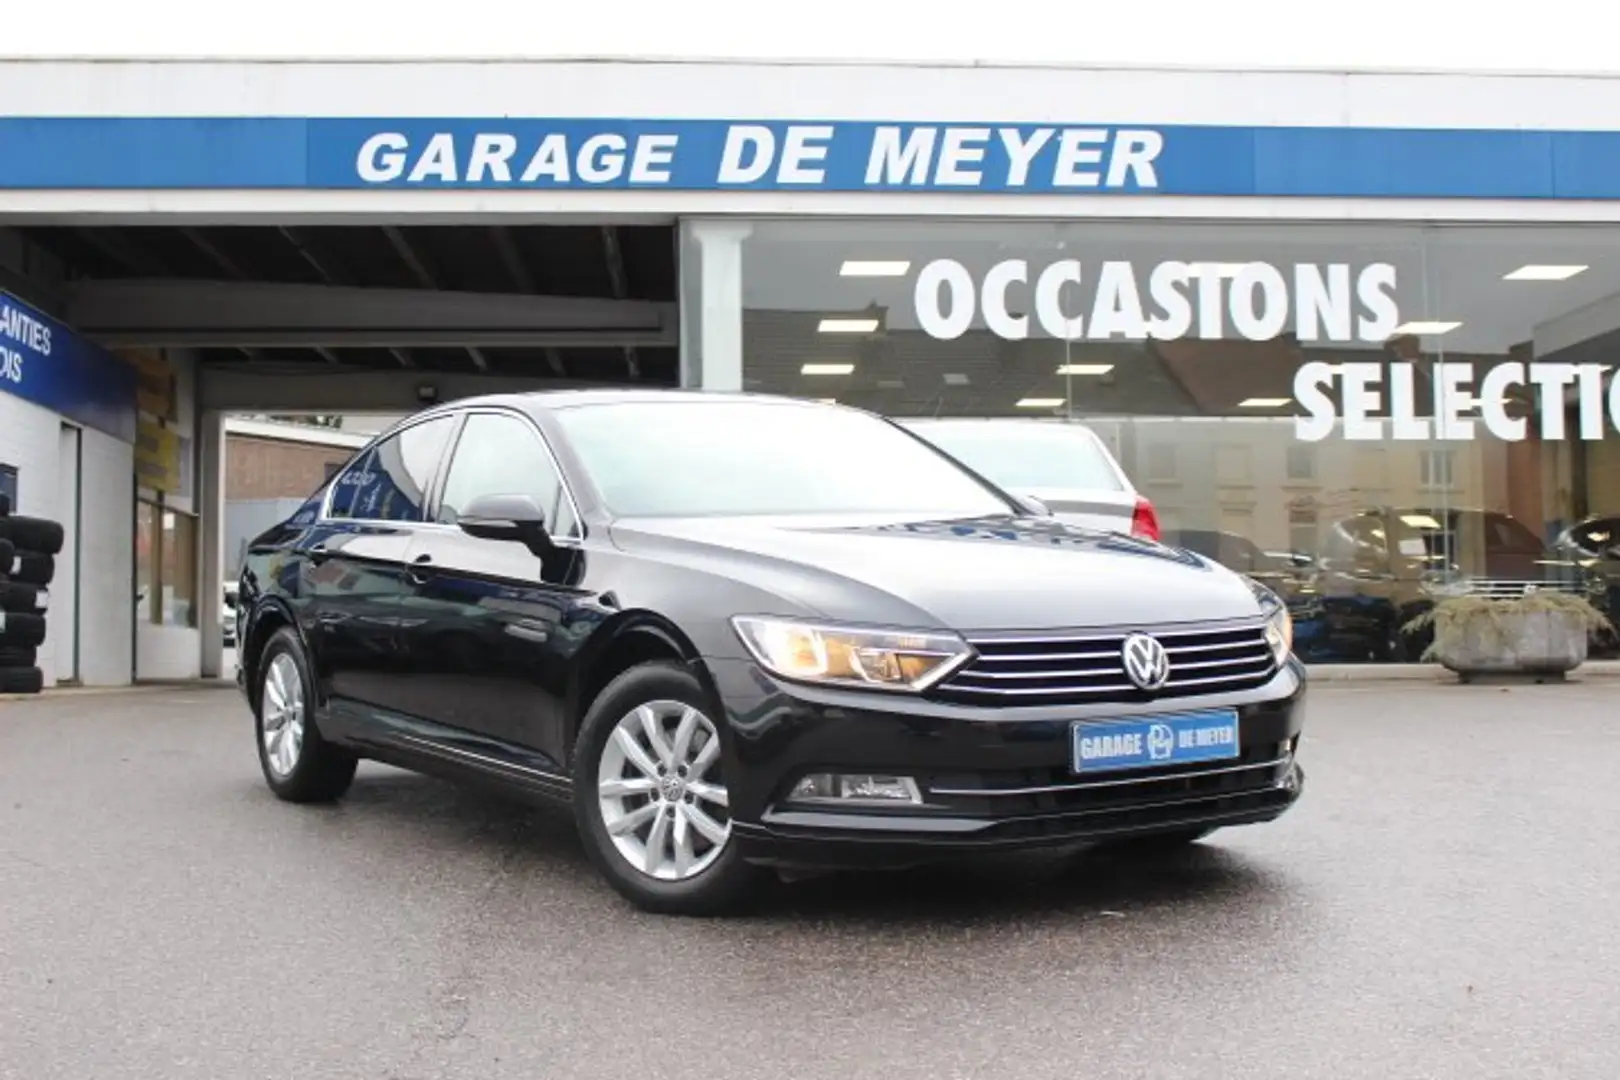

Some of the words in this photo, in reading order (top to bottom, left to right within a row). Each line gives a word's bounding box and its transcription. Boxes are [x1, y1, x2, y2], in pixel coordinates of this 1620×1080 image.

[356, 132, 678, 183] GARAGE
[716, 125, 834, 184] DE
[864, 126, 1164, 188] MEYER
[914, 258, 1399, 341] OCCASIONS
[1080, 733, 1143, 760] GARAGE
